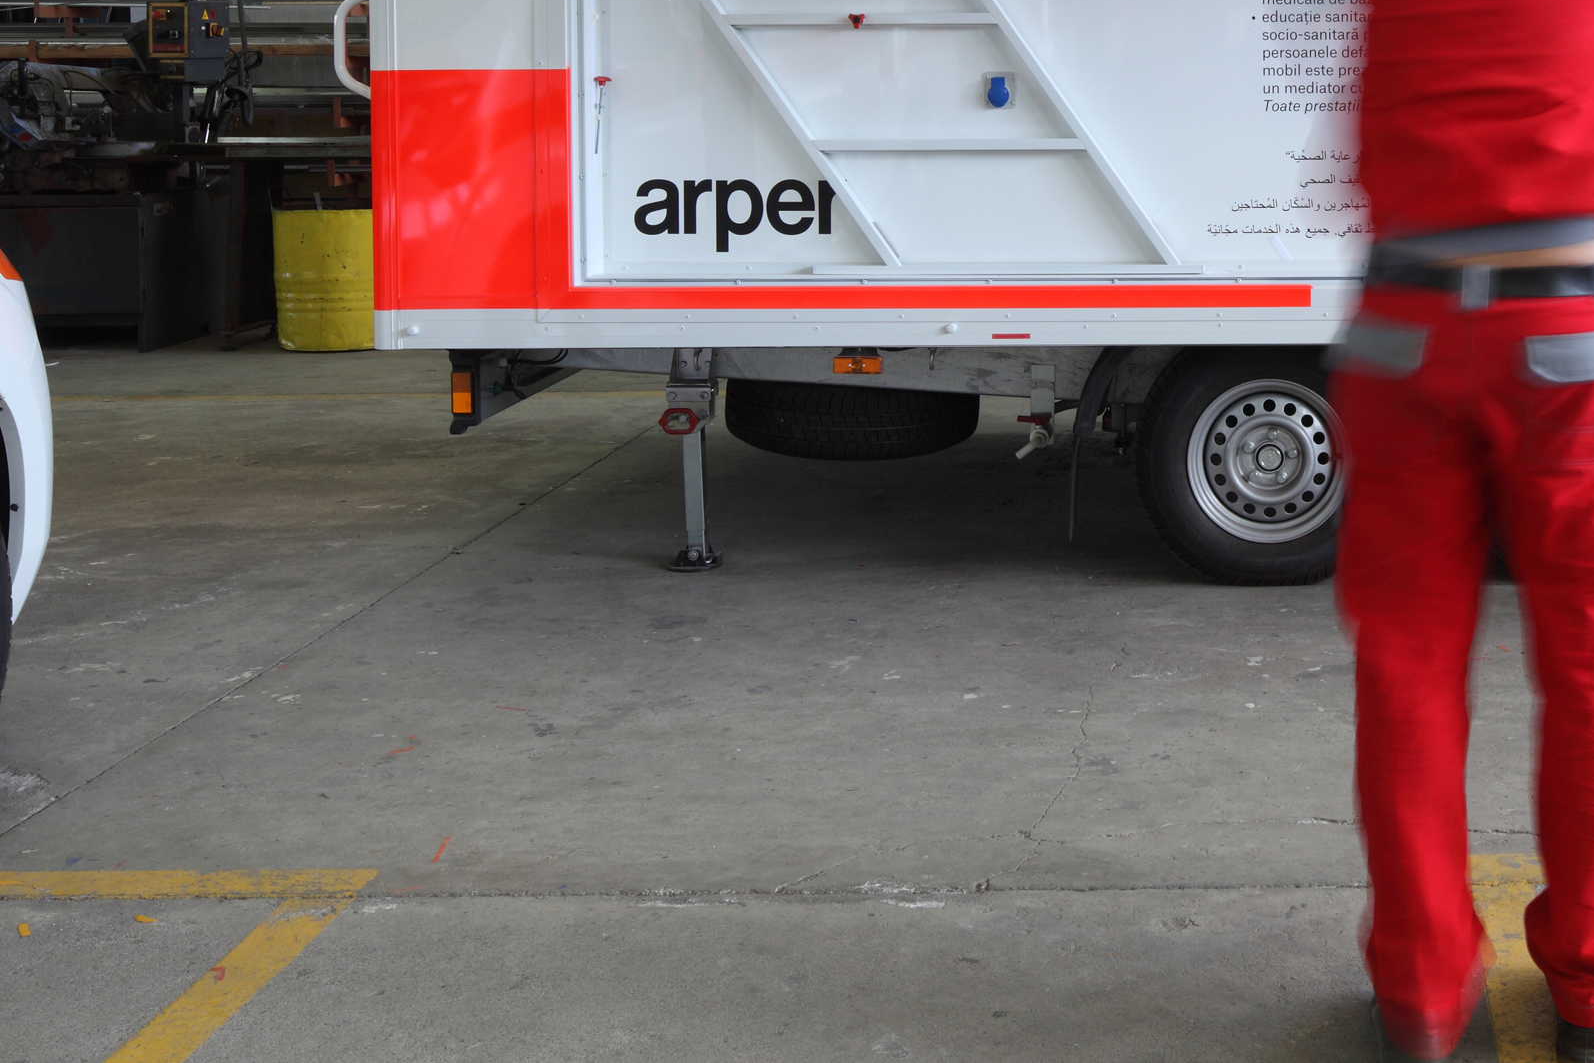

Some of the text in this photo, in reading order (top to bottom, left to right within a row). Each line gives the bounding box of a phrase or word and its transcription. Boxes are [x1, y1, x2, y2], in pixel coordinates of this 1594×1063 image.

[1262, 10, 1371, 25] educație sanitar
[1262, 28, 1359, 40] socio-sanitară
[1262, 46, 1337, 60] persoanele
[1262, 64, 1300, 76] mobil
[1305, 65, 1334, 76] este
[1263, 85, 1279, 94] un
[1284, 81, 1345, 94] mediator
[1264, 100, 1361, 114] Toate prestații
[634, 179, 836, 252] arper
